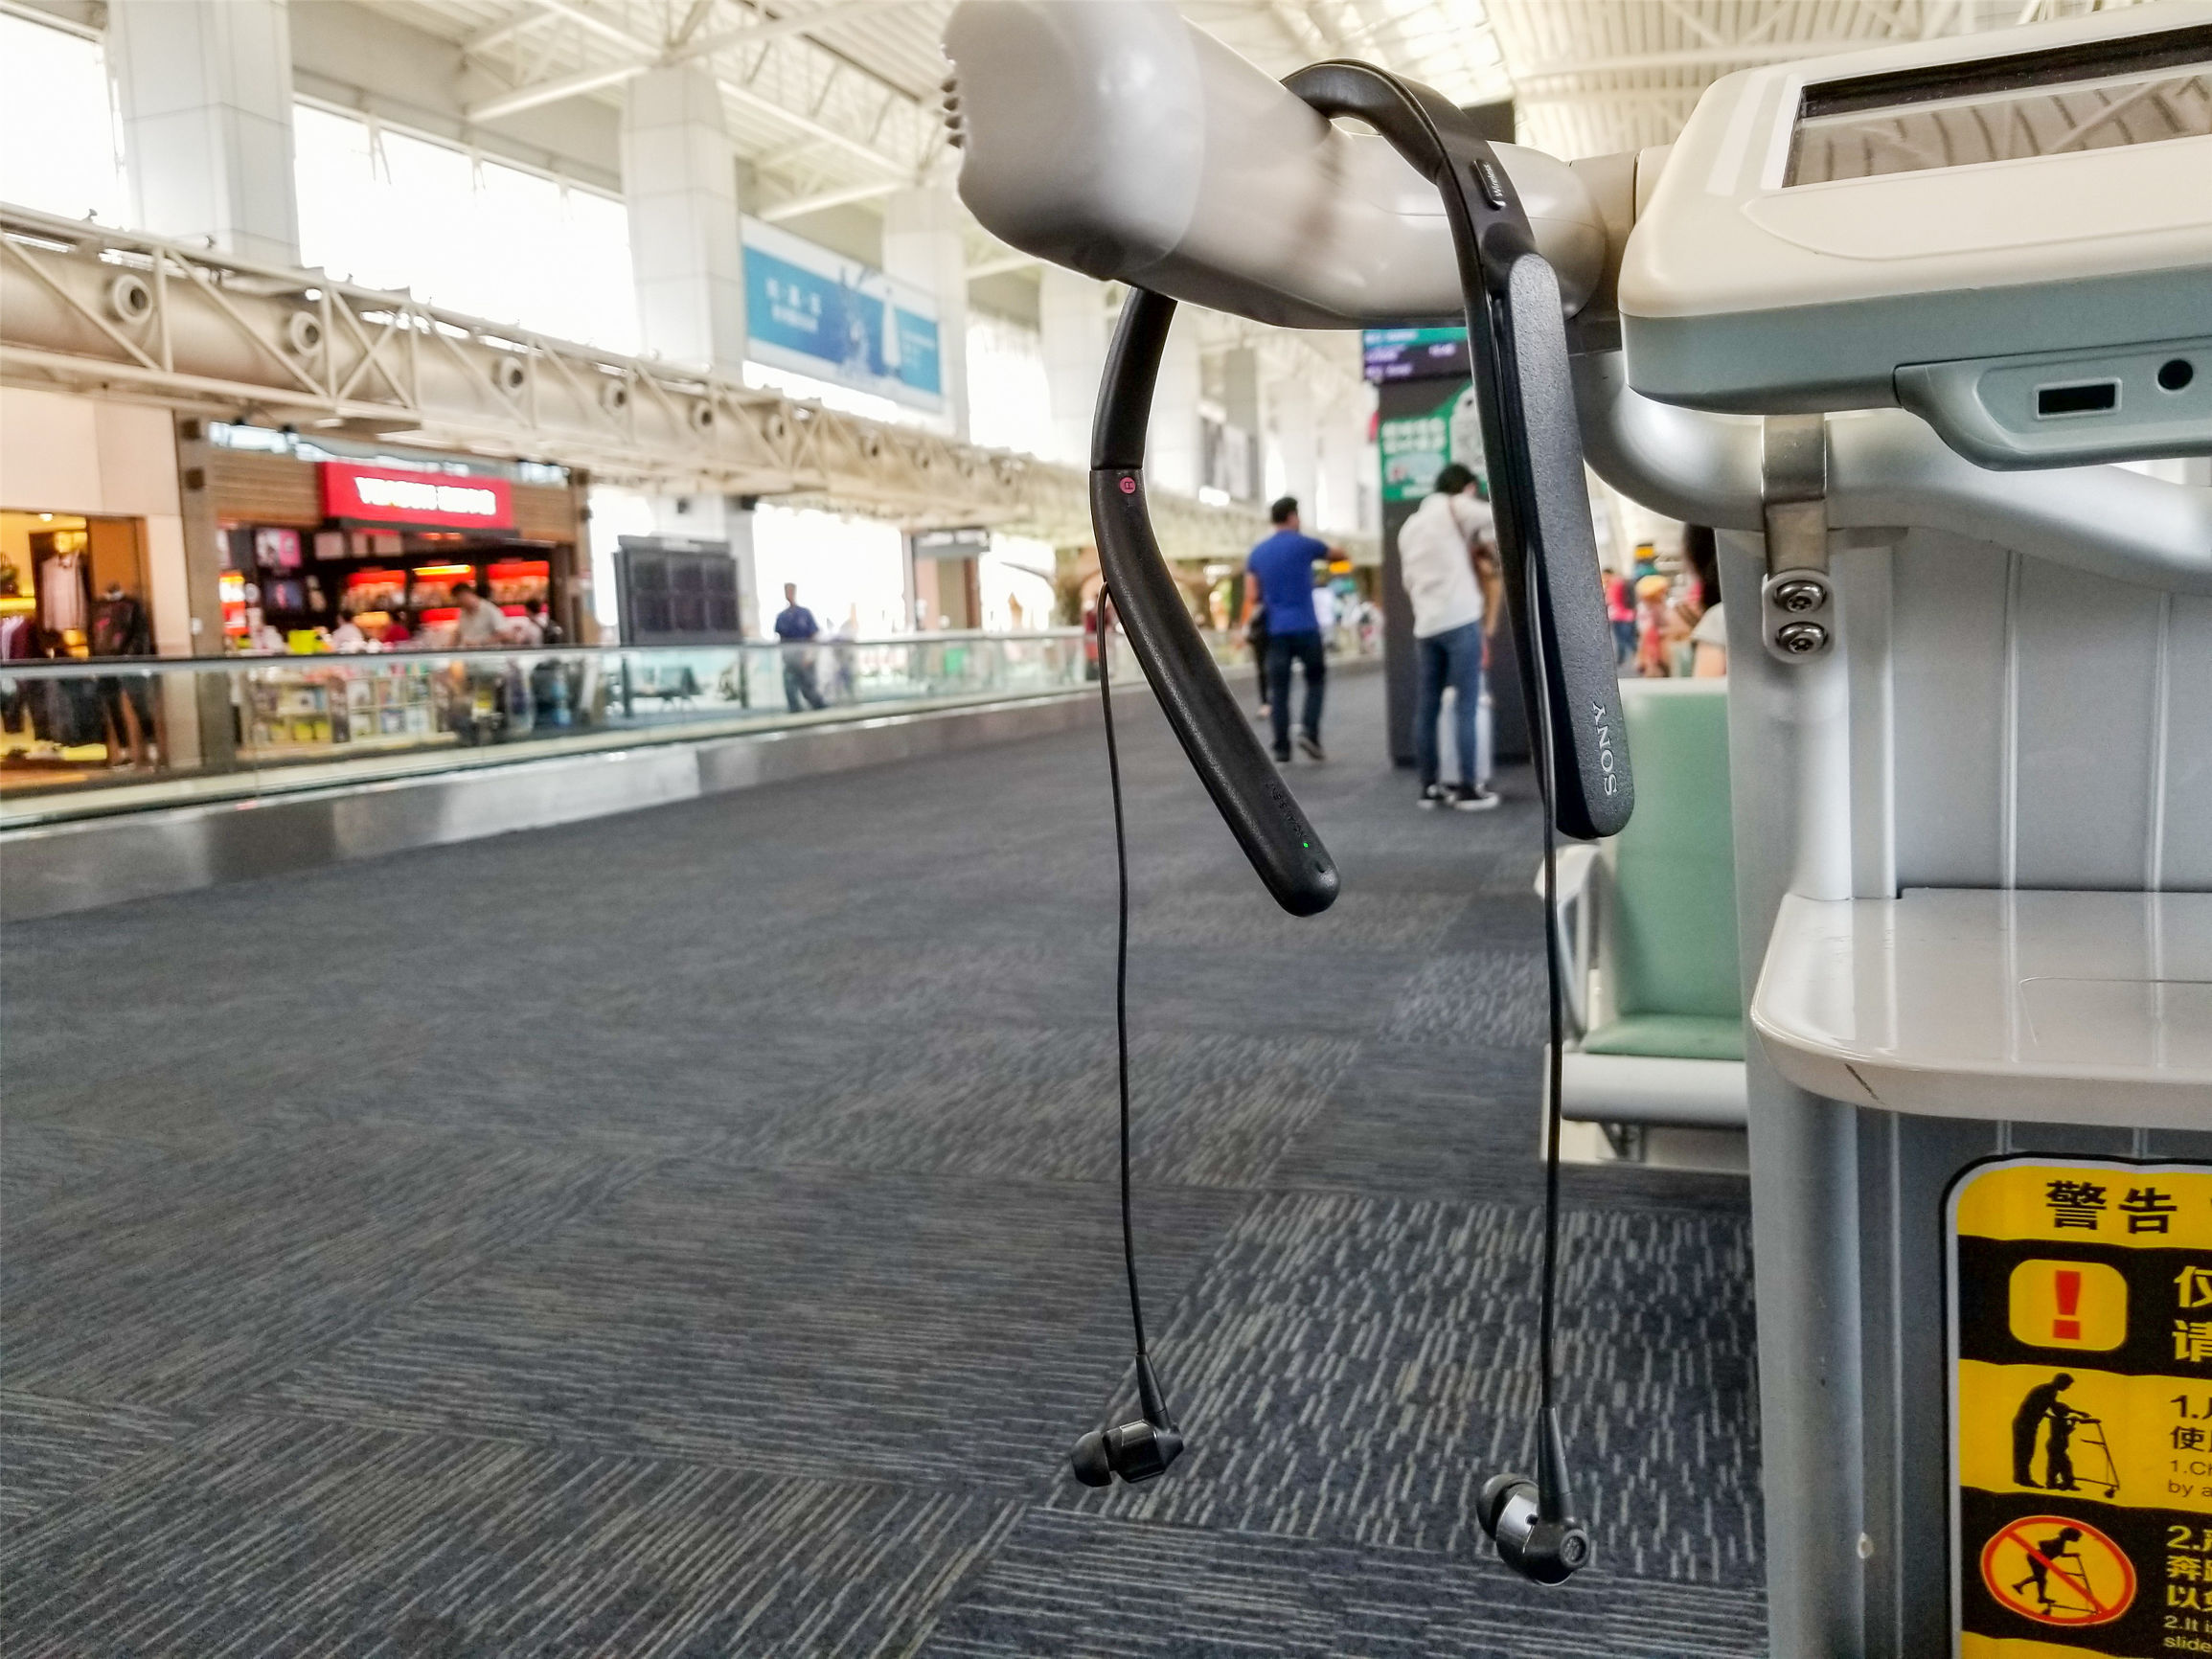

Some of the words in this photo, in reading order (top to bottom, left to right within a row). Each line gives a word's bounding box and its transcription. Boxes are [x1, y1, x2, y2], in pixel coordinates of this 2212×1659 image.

[1592, 702, 1618, 796] SONY
[2045, 1180, 2178, 1235] 警告
[2170, 1395, 2212, 1420] 1.
[2169, 1425, 2212, 1452] 使
[2168, 1479, 2194, 1497] by
[2166, 1525, 2212, 1552] 2.
[2166, 1555, 2212, 1581] 奔
[2166, 1584, 2212, 1612] 以
[2163, 1614, 2199, 1632] 2.It
[2163, 1635, 2212, 1653] slide
